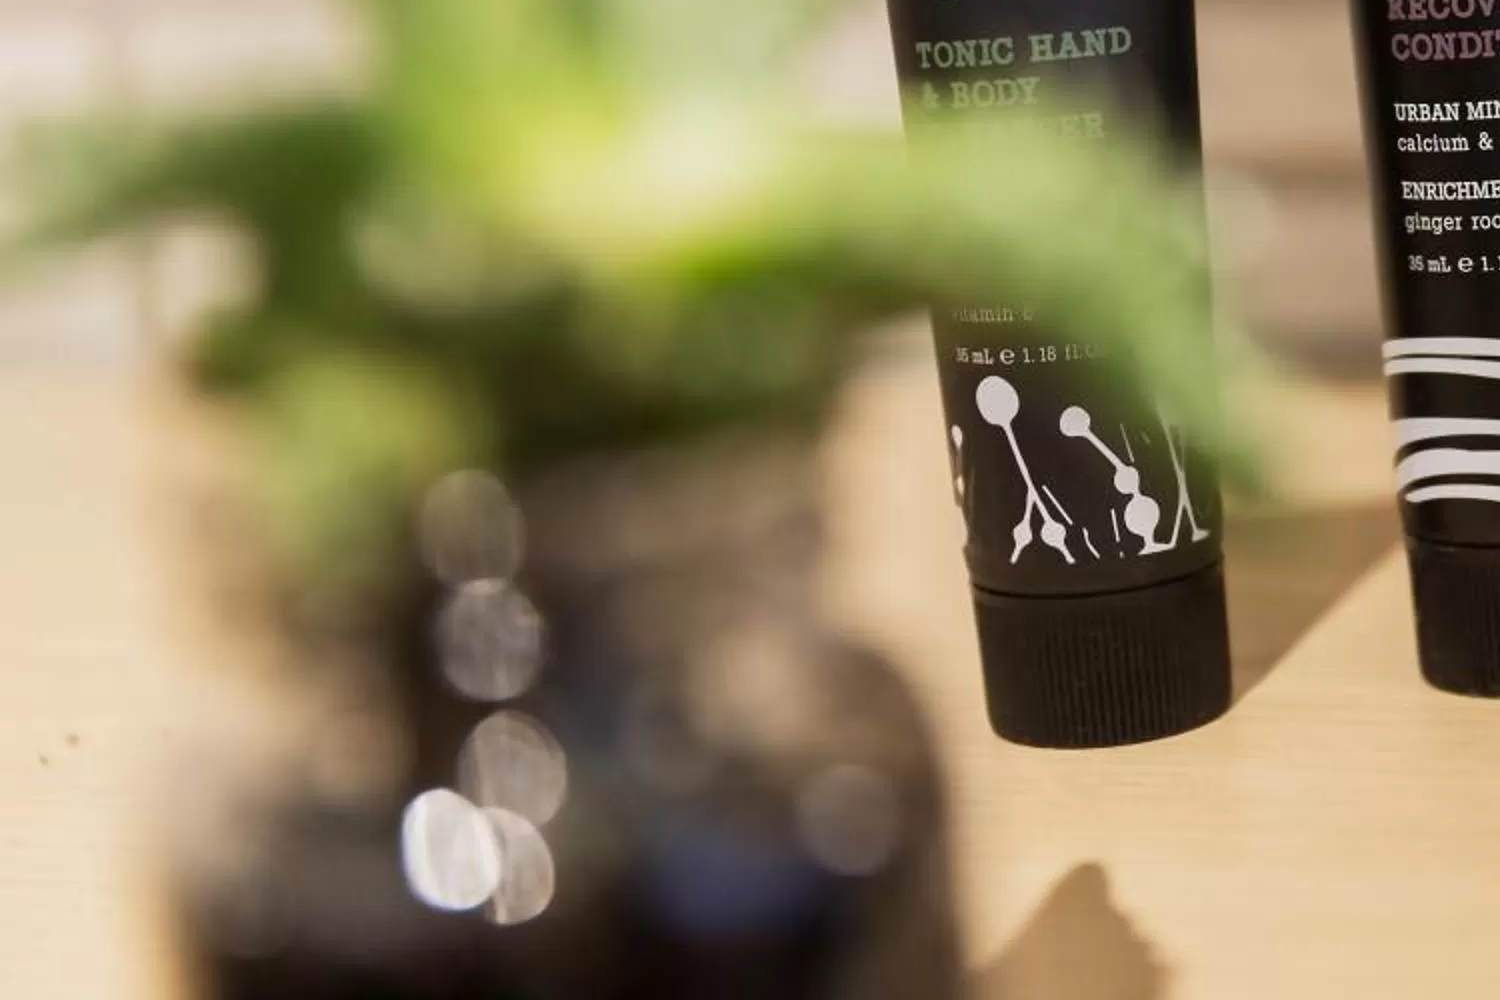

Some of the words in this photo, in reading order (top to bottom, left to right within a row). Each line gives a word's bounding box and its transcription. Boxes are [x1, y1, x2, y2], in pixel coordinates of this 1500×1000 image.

[916, 37, 1013, 69] TONIC
[1028, 26, 1132, 63] HAND
[950, 77, 1041, 109] BODY
[1394, 102, 1460, 122] URBAN
[1397, 133, 1469, 153] calcium
[1479, 132, 1493, 150] &
[1405, 212, 1463, 234] ginger
[1428, 257, 1450, 273] mL
